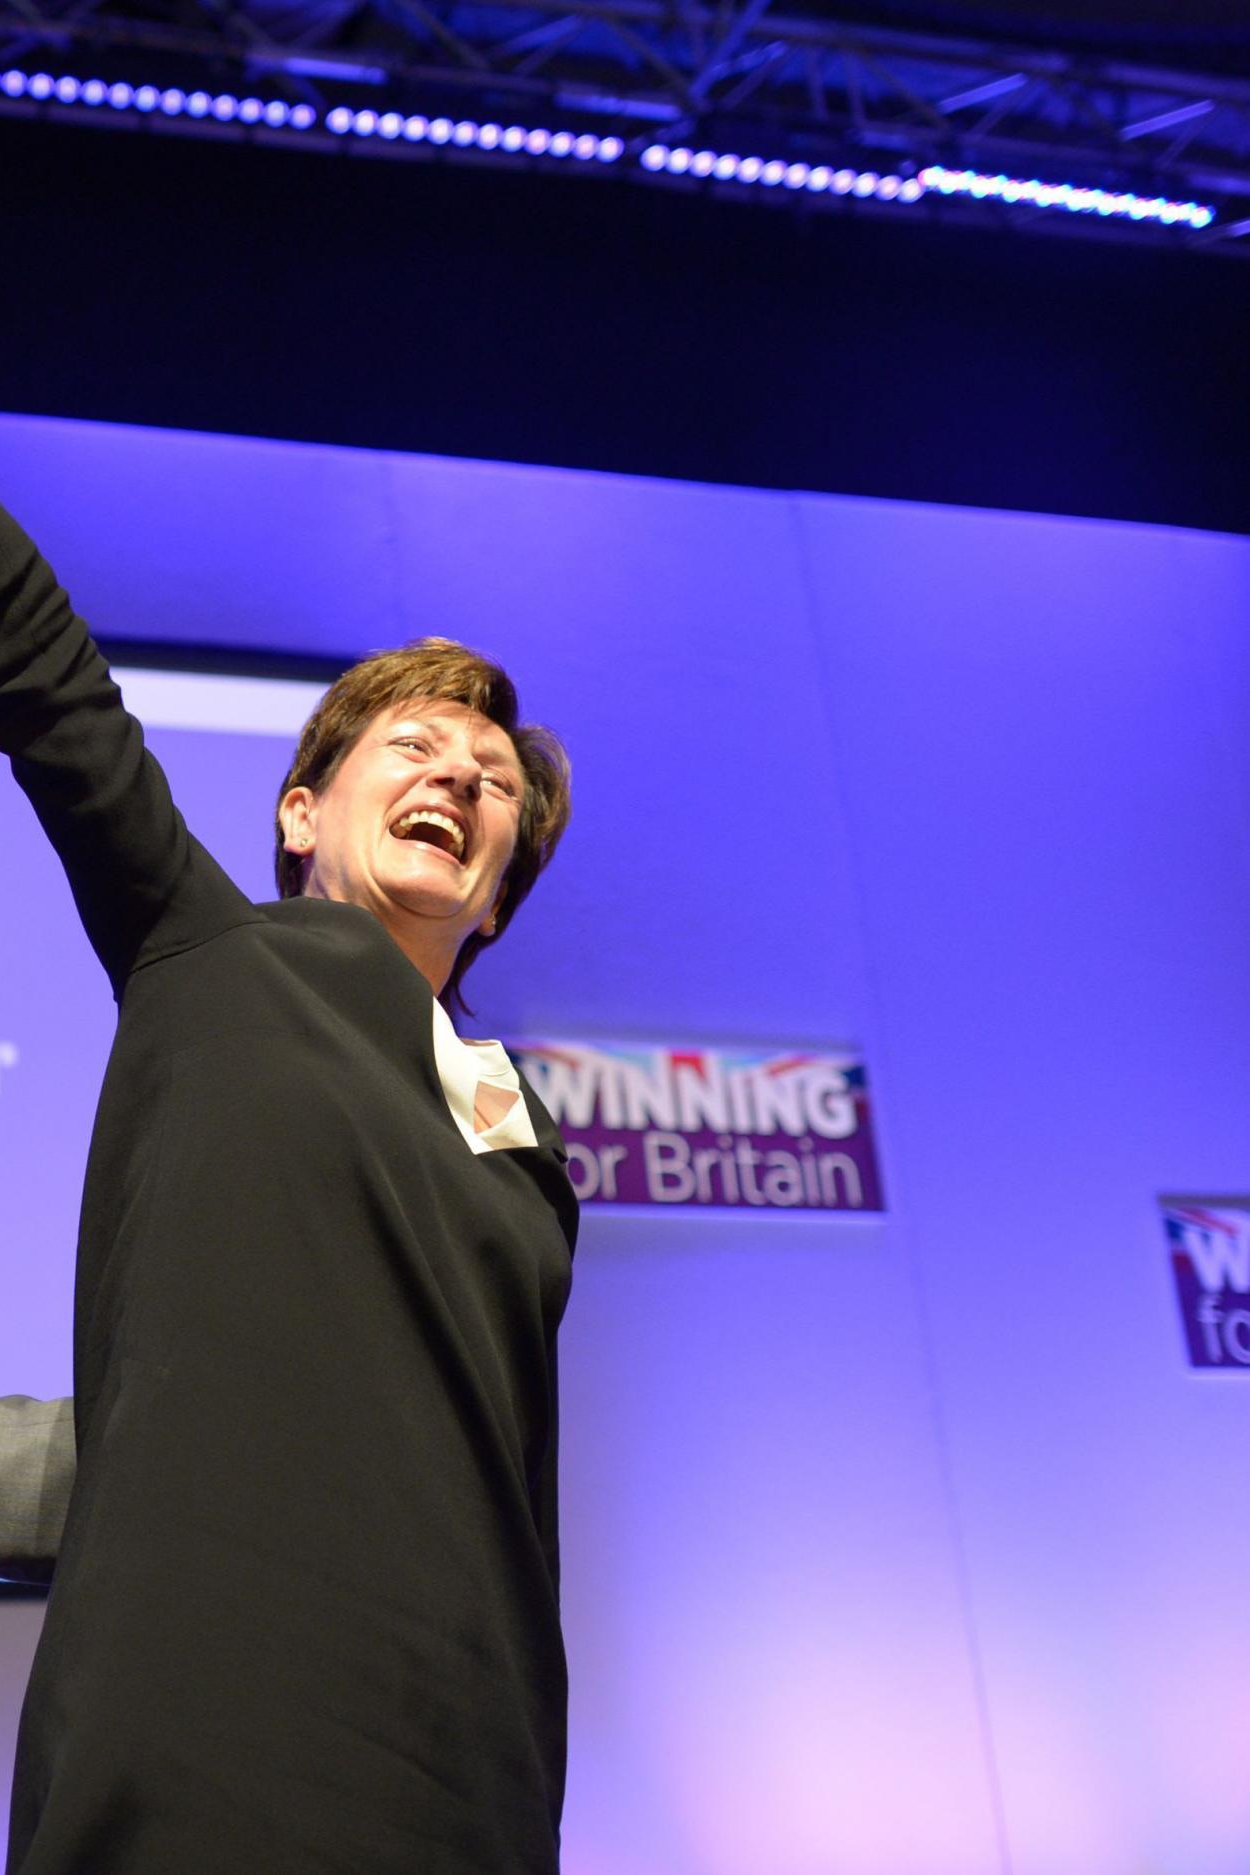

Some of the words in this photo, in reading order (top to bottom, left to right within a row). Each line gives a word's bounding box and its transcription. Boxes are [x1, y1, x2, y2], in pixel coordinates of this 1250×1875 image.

[524, 1058, 857, 1138] WINNING
[566, 1142, 628, 1201] or
[644, 1131, 862, 1208] Britain
[1199, 1294, 1250, 1365] fo
